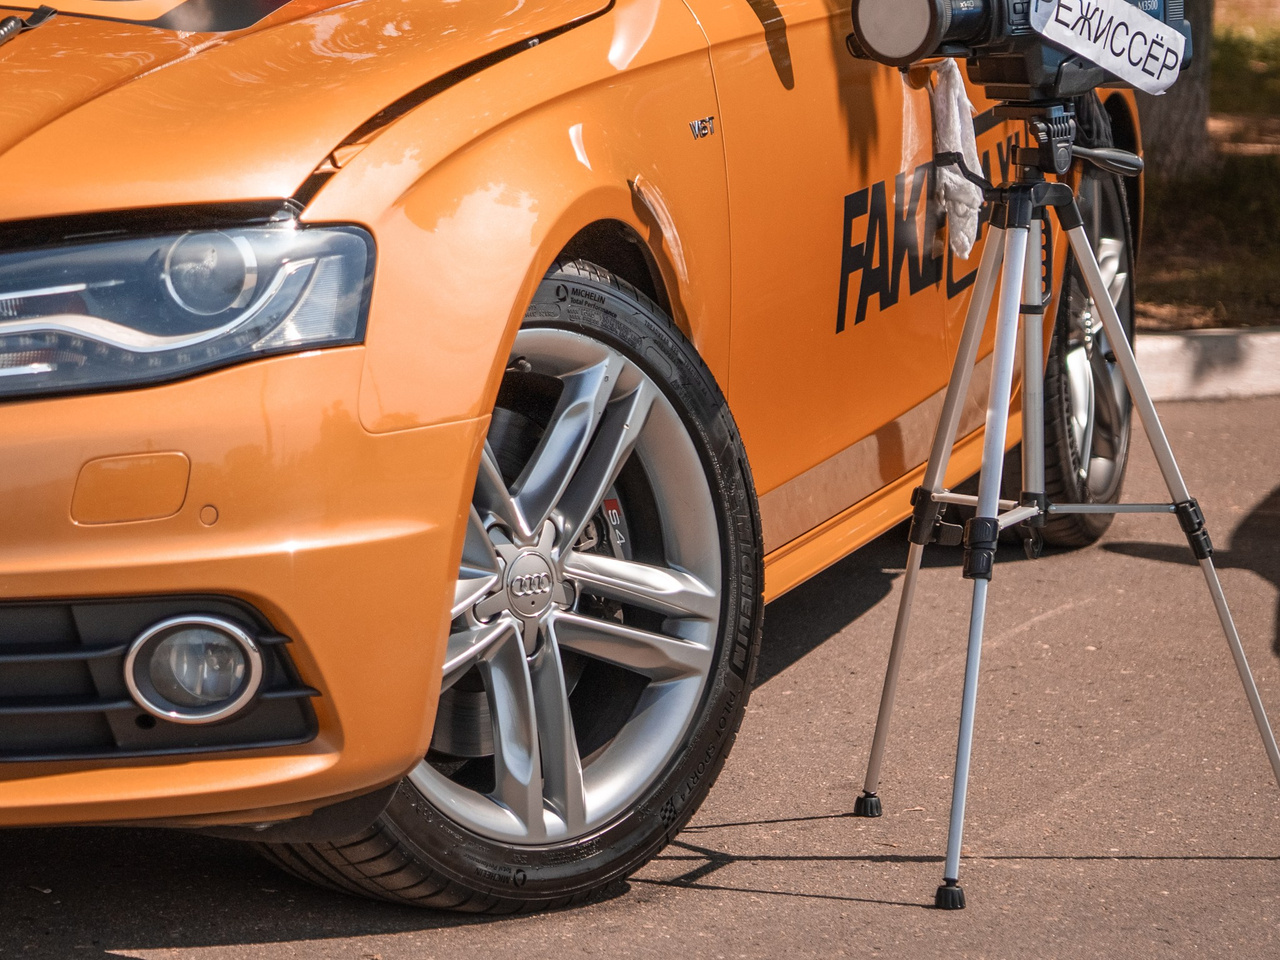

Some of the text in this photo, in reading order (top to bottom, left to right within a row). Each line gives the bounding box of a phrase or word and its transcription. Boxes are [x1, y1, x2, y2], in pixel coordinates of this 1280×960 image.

[571, 287, 606, 304] MICHELIN
[732, 513, 755, 672] MICHELIN
[687, 743, 716, 793] SPORT
